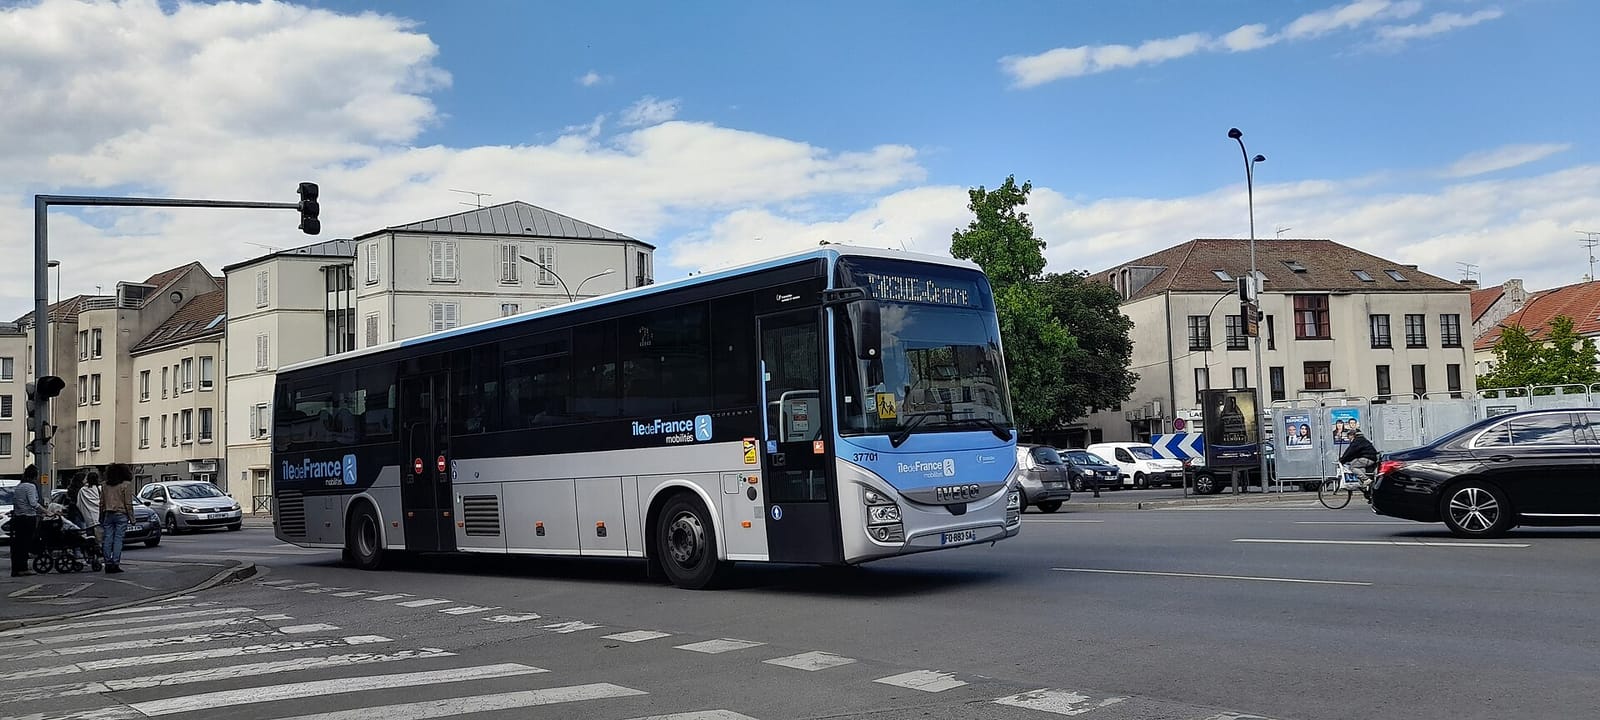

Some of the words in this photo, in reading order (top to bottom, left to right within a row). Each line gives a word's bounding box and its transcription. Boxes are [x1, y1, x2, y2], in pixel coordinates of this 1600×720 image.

[665, 432, 694, 444] mobilités
[853, 452, 878, 462] 37701
[936, 484, 980, 501] IVECO
